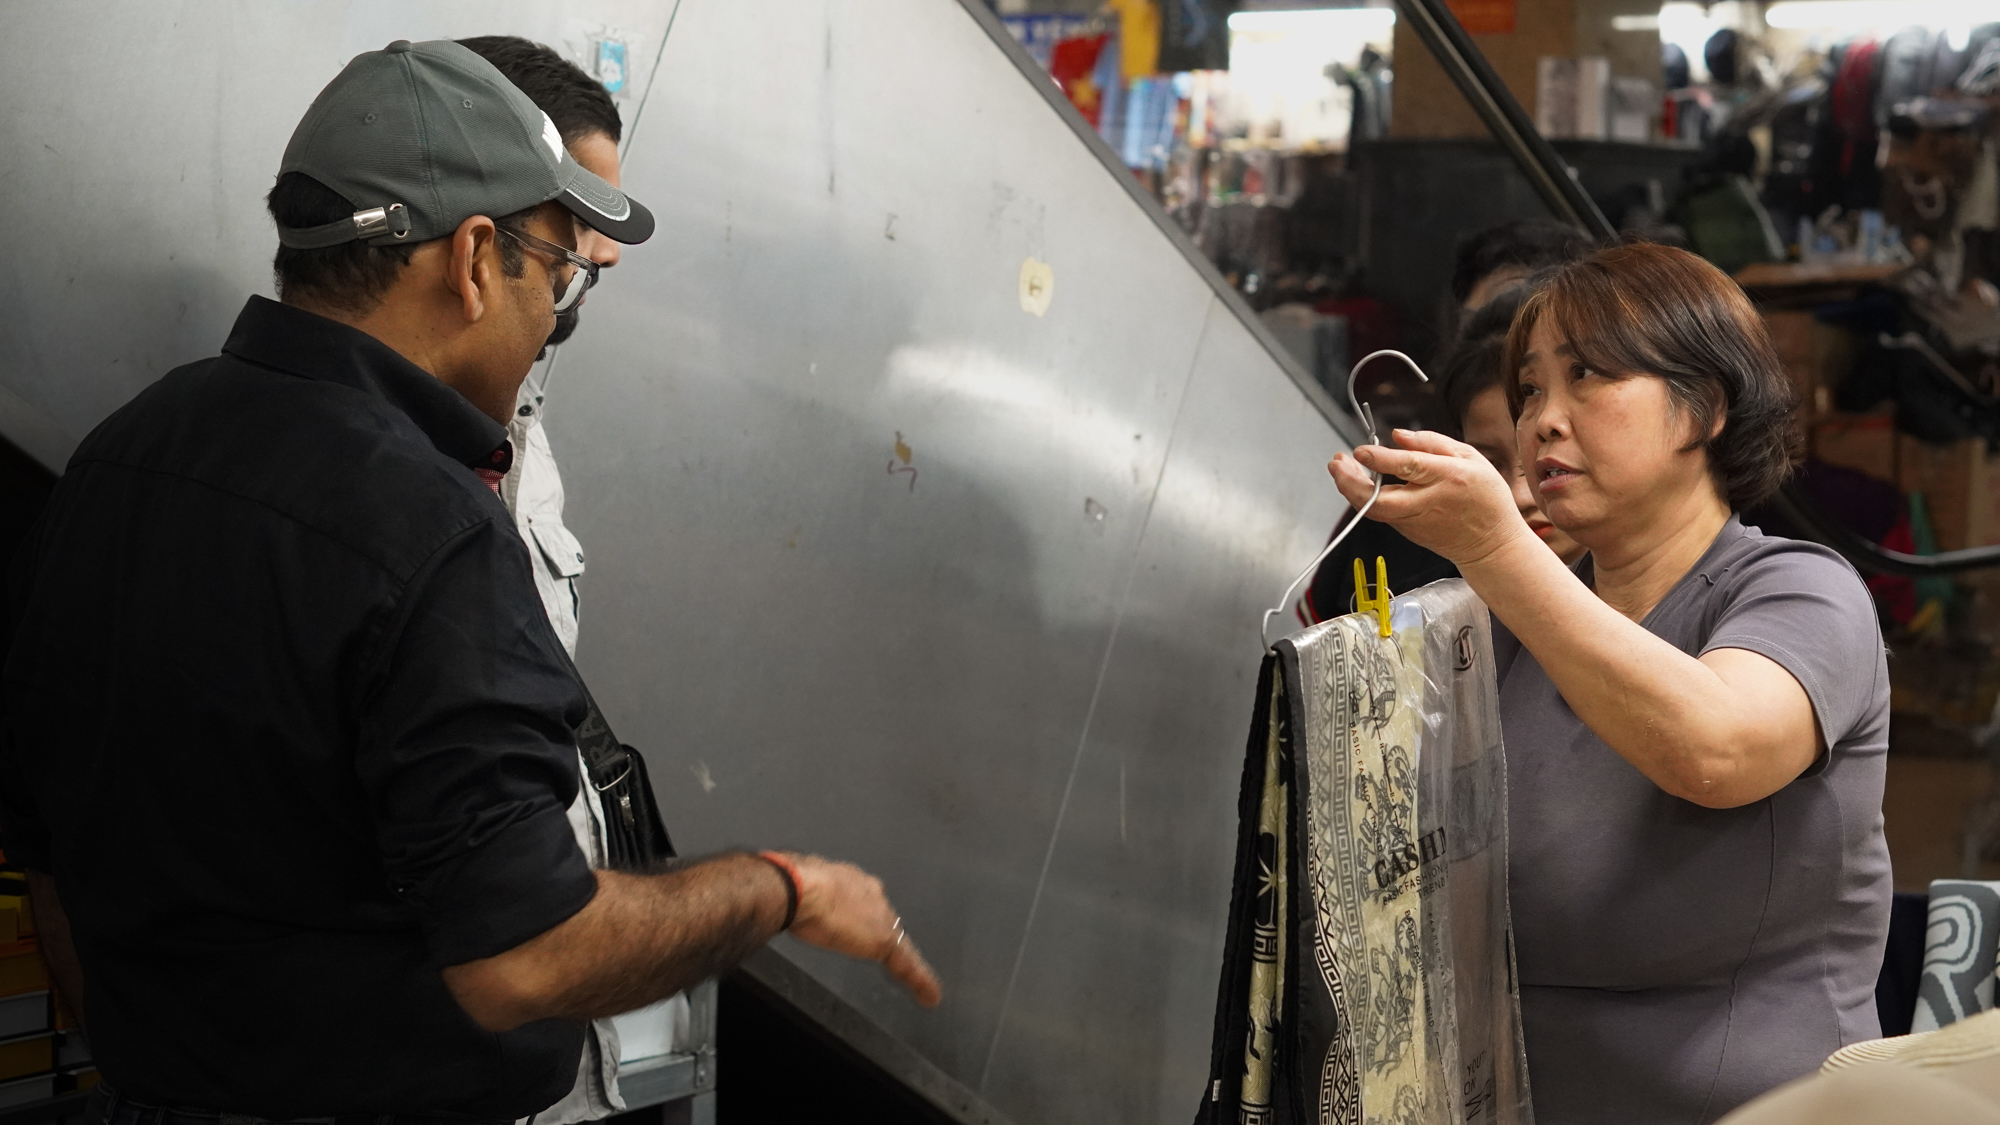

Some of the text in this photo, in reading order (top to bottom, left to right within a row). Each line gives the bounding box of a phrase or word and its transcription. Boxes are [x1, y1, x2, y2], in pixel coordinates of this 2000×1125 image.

[1350, 721, 1361, 756] BASIC
[1383, 864, 1443, 906] BASIC FASHION
[1417, 877, 1446, 899] TREND
